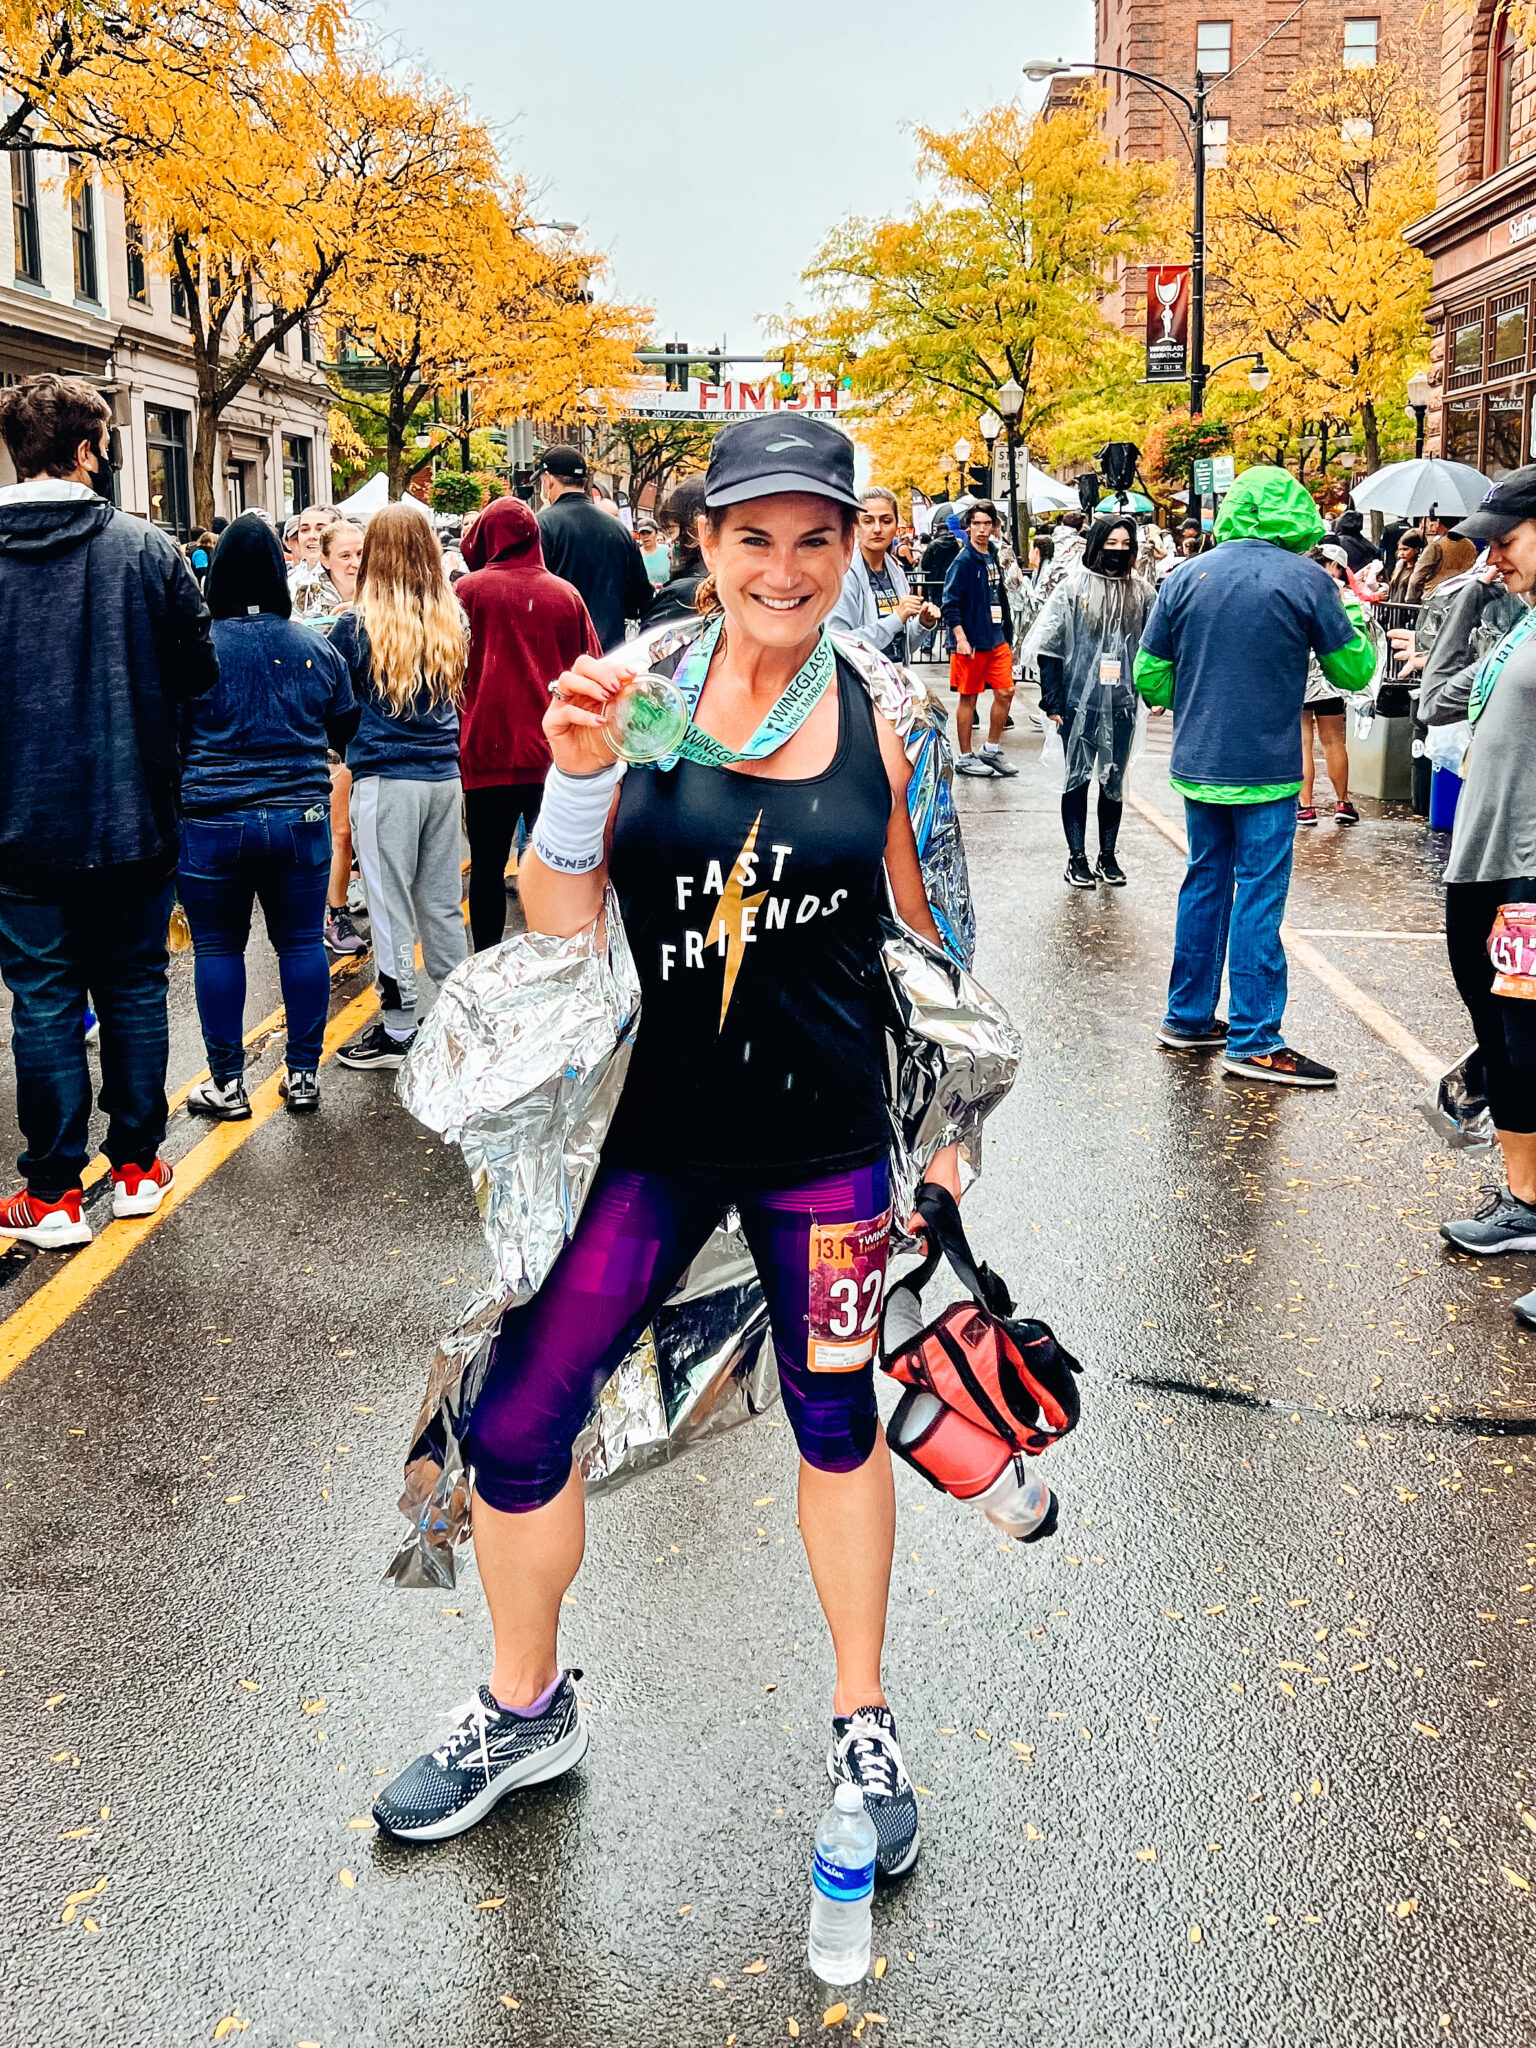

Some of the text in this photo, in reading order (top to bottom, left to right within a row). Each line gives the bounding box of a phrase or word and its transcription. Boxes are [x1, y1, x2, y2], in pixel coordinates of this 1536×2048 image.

[651, 410, 671, 418] 2021
[700, 381, 837, 410] FINISH
[768, 646, 828, 723] WINEGLASS
[785, 662, 834, 729] HALF MARATHON
[537, 840, 597, 869] ZENSAH
[676, 844, 793, 911] FAST
[662, 888, 849, 981] FRIENDS
[815, 1237, 845, 1260] 13.1
[829, 1269, 883, 1337] 32
